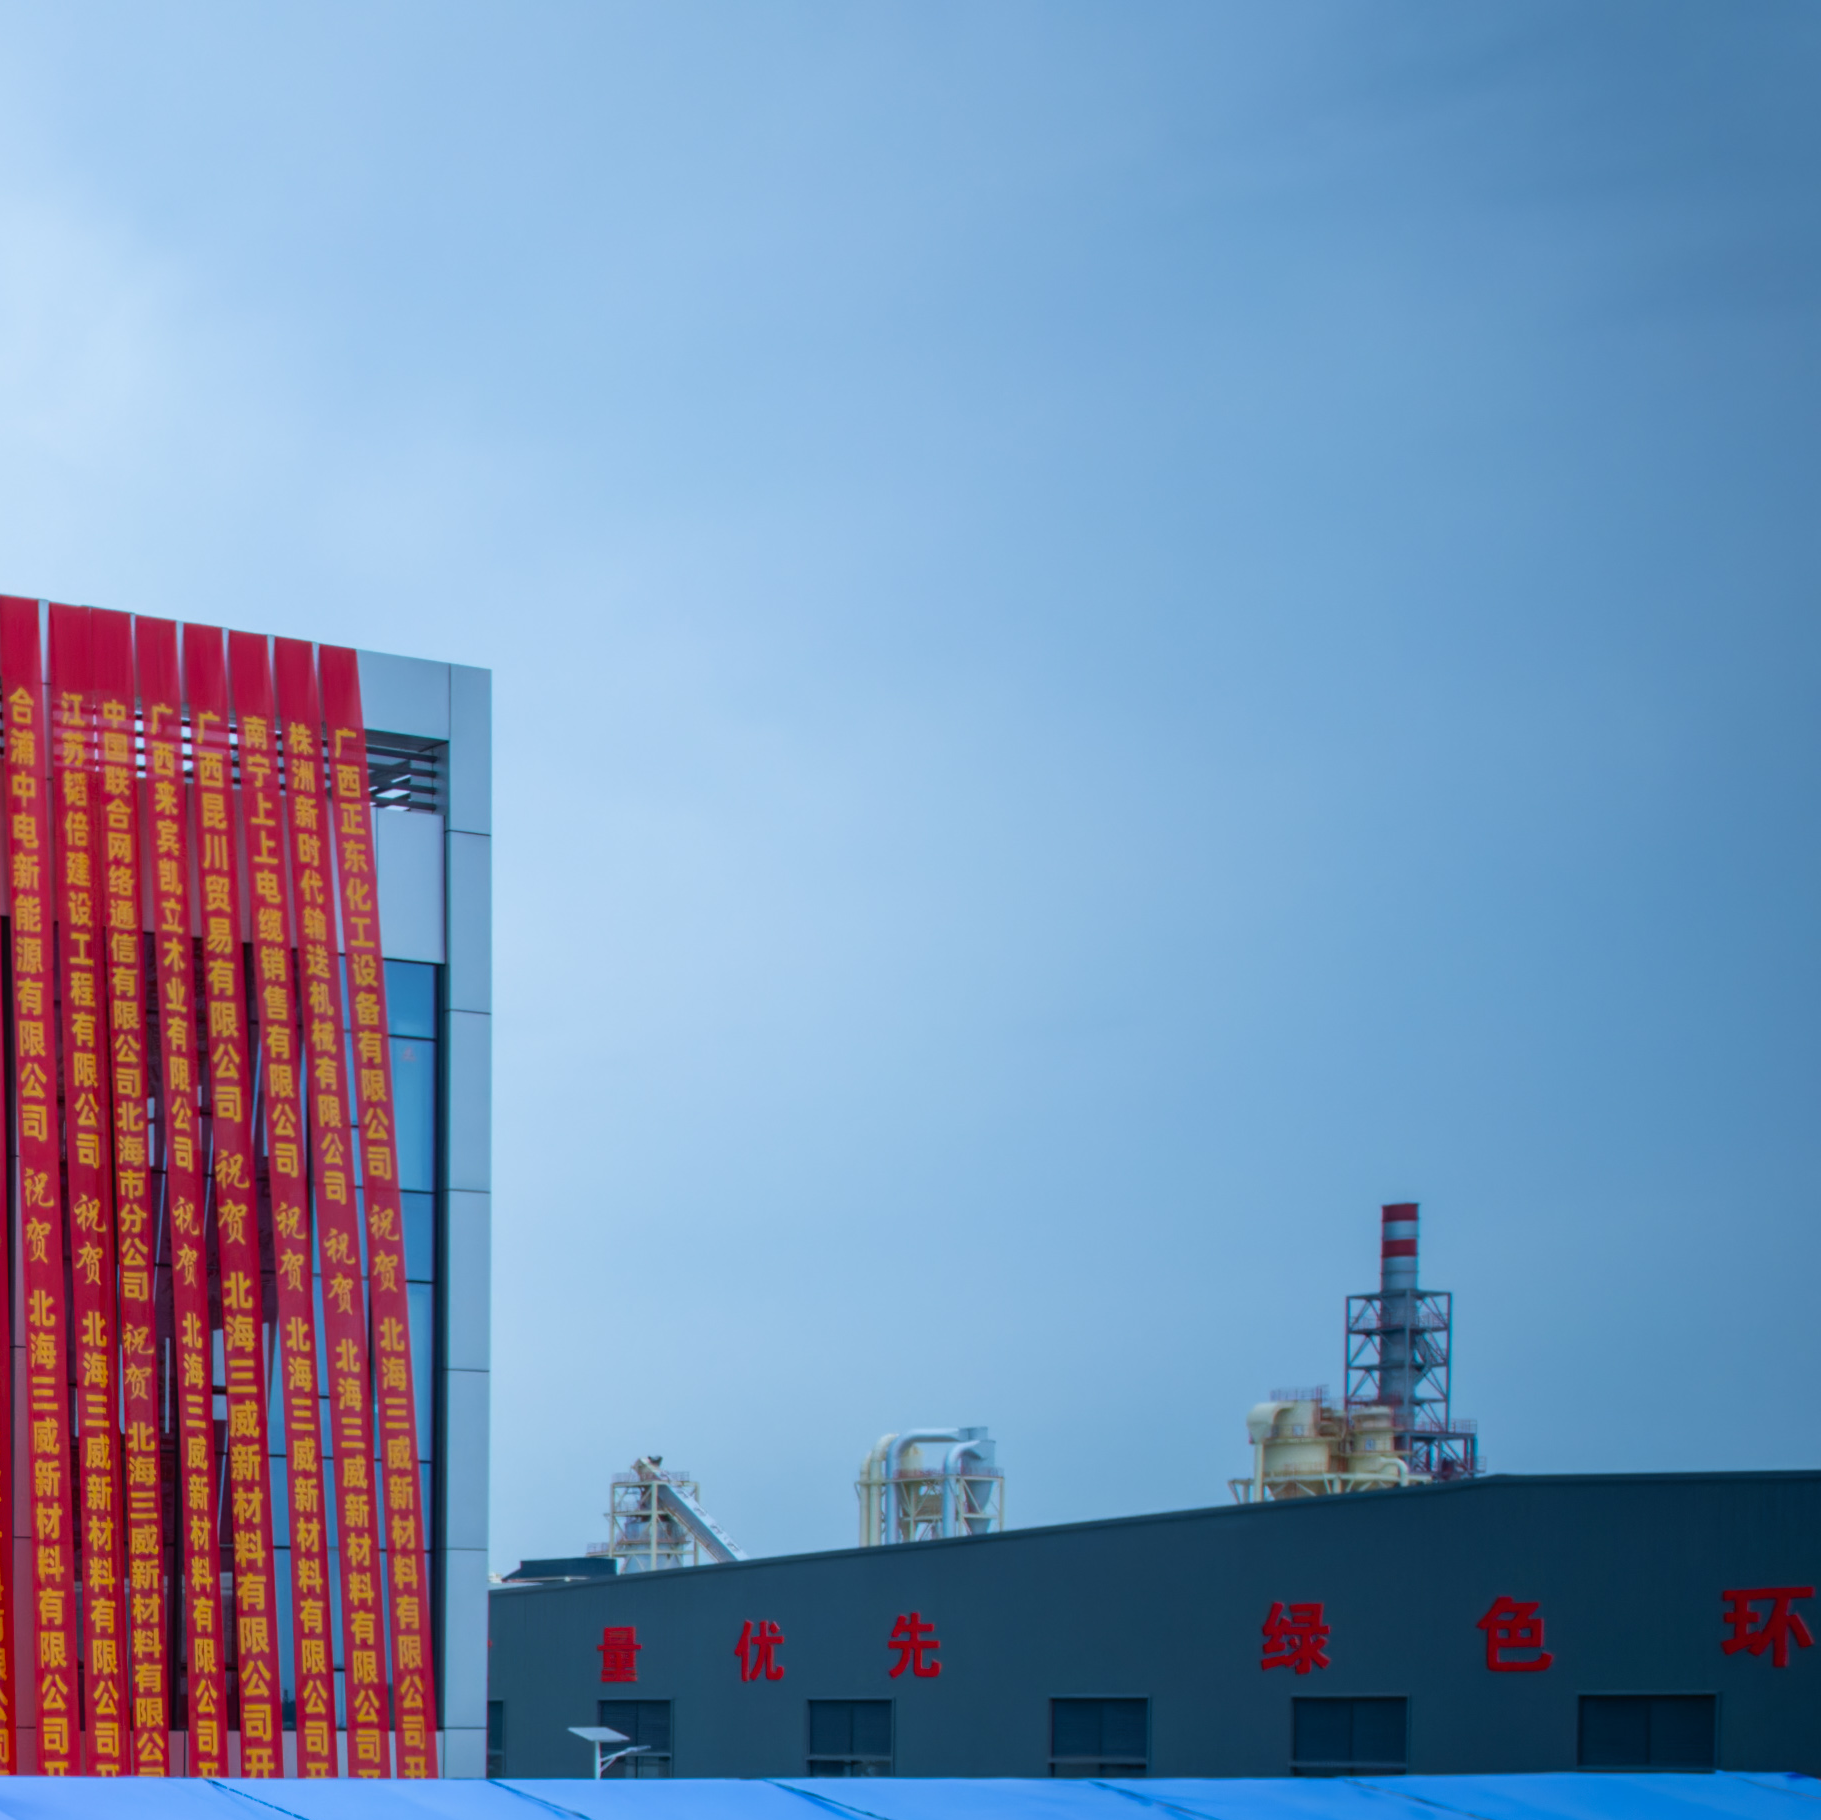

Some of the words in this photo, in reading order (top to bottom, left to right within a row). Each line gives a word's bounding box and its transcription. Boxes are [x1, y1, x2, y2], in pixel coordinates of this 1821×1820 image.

[7, 687, 49, 1142] 合浦中电新能源有限公司
[102, 700, 150, 1302] 中国联合网络通信有限公司北海市分公司
[150, 703, 194, 1172] 广西来宾凯立木业有限公司
[196, 711, 243, 1123] 广西昆川贸易有限公司
[243, 716, 300, 1178] 南宁上上电缆销售有限公司
[275, 1202, 307, 1289] 祝贺
[288, 723, 348, 1204] 株洲新时代输送机械有限公司
[334, 728, 393, 1180] 广西正东化工设备有限公司
[369, 1205, 400, 1290] 祝贺
[23, 1168, 56, 1263] 祝贺
[72, 1194, 108, 1284] 祝贺
[171, 1197, 201, 1284] 祝贺
[213, 1150, 251, 1243] 祝贺
[323, 1228, 357, 1311] 祝贺
[121, 1323, 155, 1399] 祝贺
[334, 1338, 382, 1779] 北海三威新材料有限公司
[597, 1612, 942, 1683] 量优先
[1258, 1586, 1815, 1676] 绿色环
